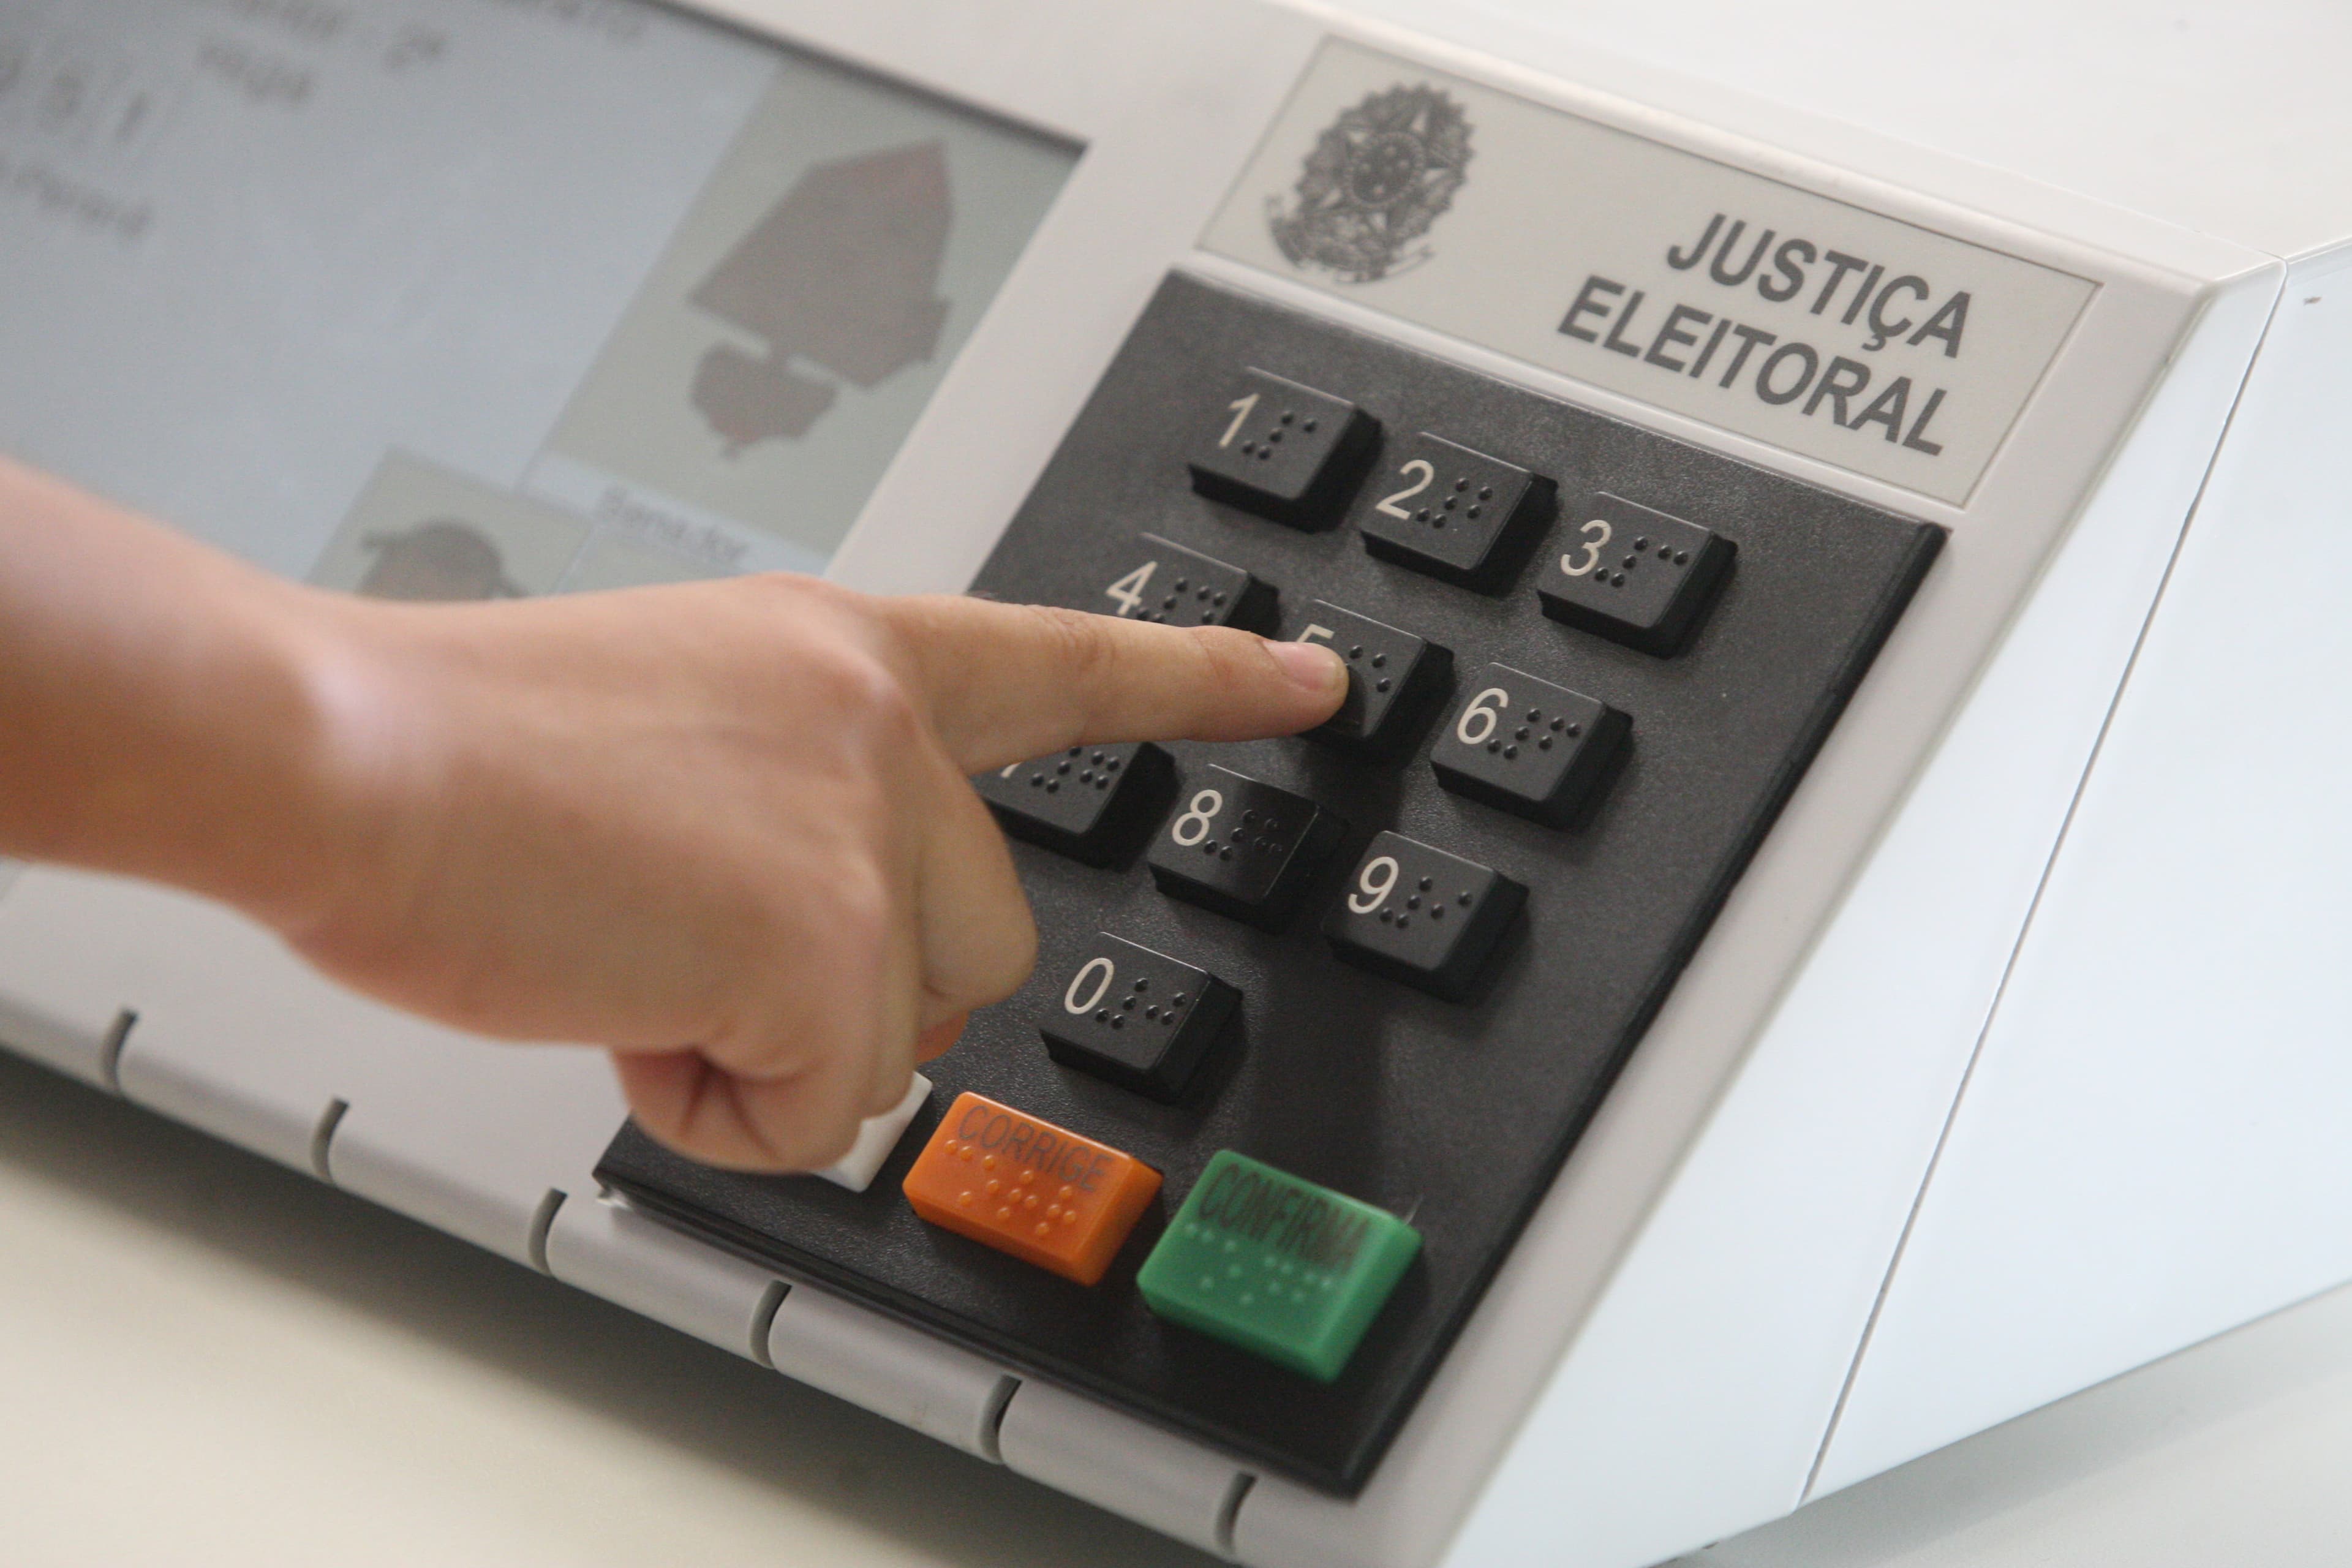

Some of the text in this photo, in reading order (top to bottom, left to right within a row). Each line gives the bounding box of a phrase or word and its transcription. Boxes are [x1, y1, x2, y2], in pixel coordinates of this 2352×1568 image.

[1667, 213, 1972, 359] JUSTIÇA
[1557, 275, 1947, 456] ELEITORAL
[1219, 394, 1258, 447] 1
[1376, 459, 1434, 519] 2
[1561, 519, 1611, 576] 3
[1106, 561, 1157, 616] 4
[1458, 688, 1508, 744] 6
[1172, 790, 1223, 846] 8
[1349, 856, 1399, 913] 9
[1065, 957, 1114, 1014] 0
[958, 1105, 1112, 1193] CORRIGE
